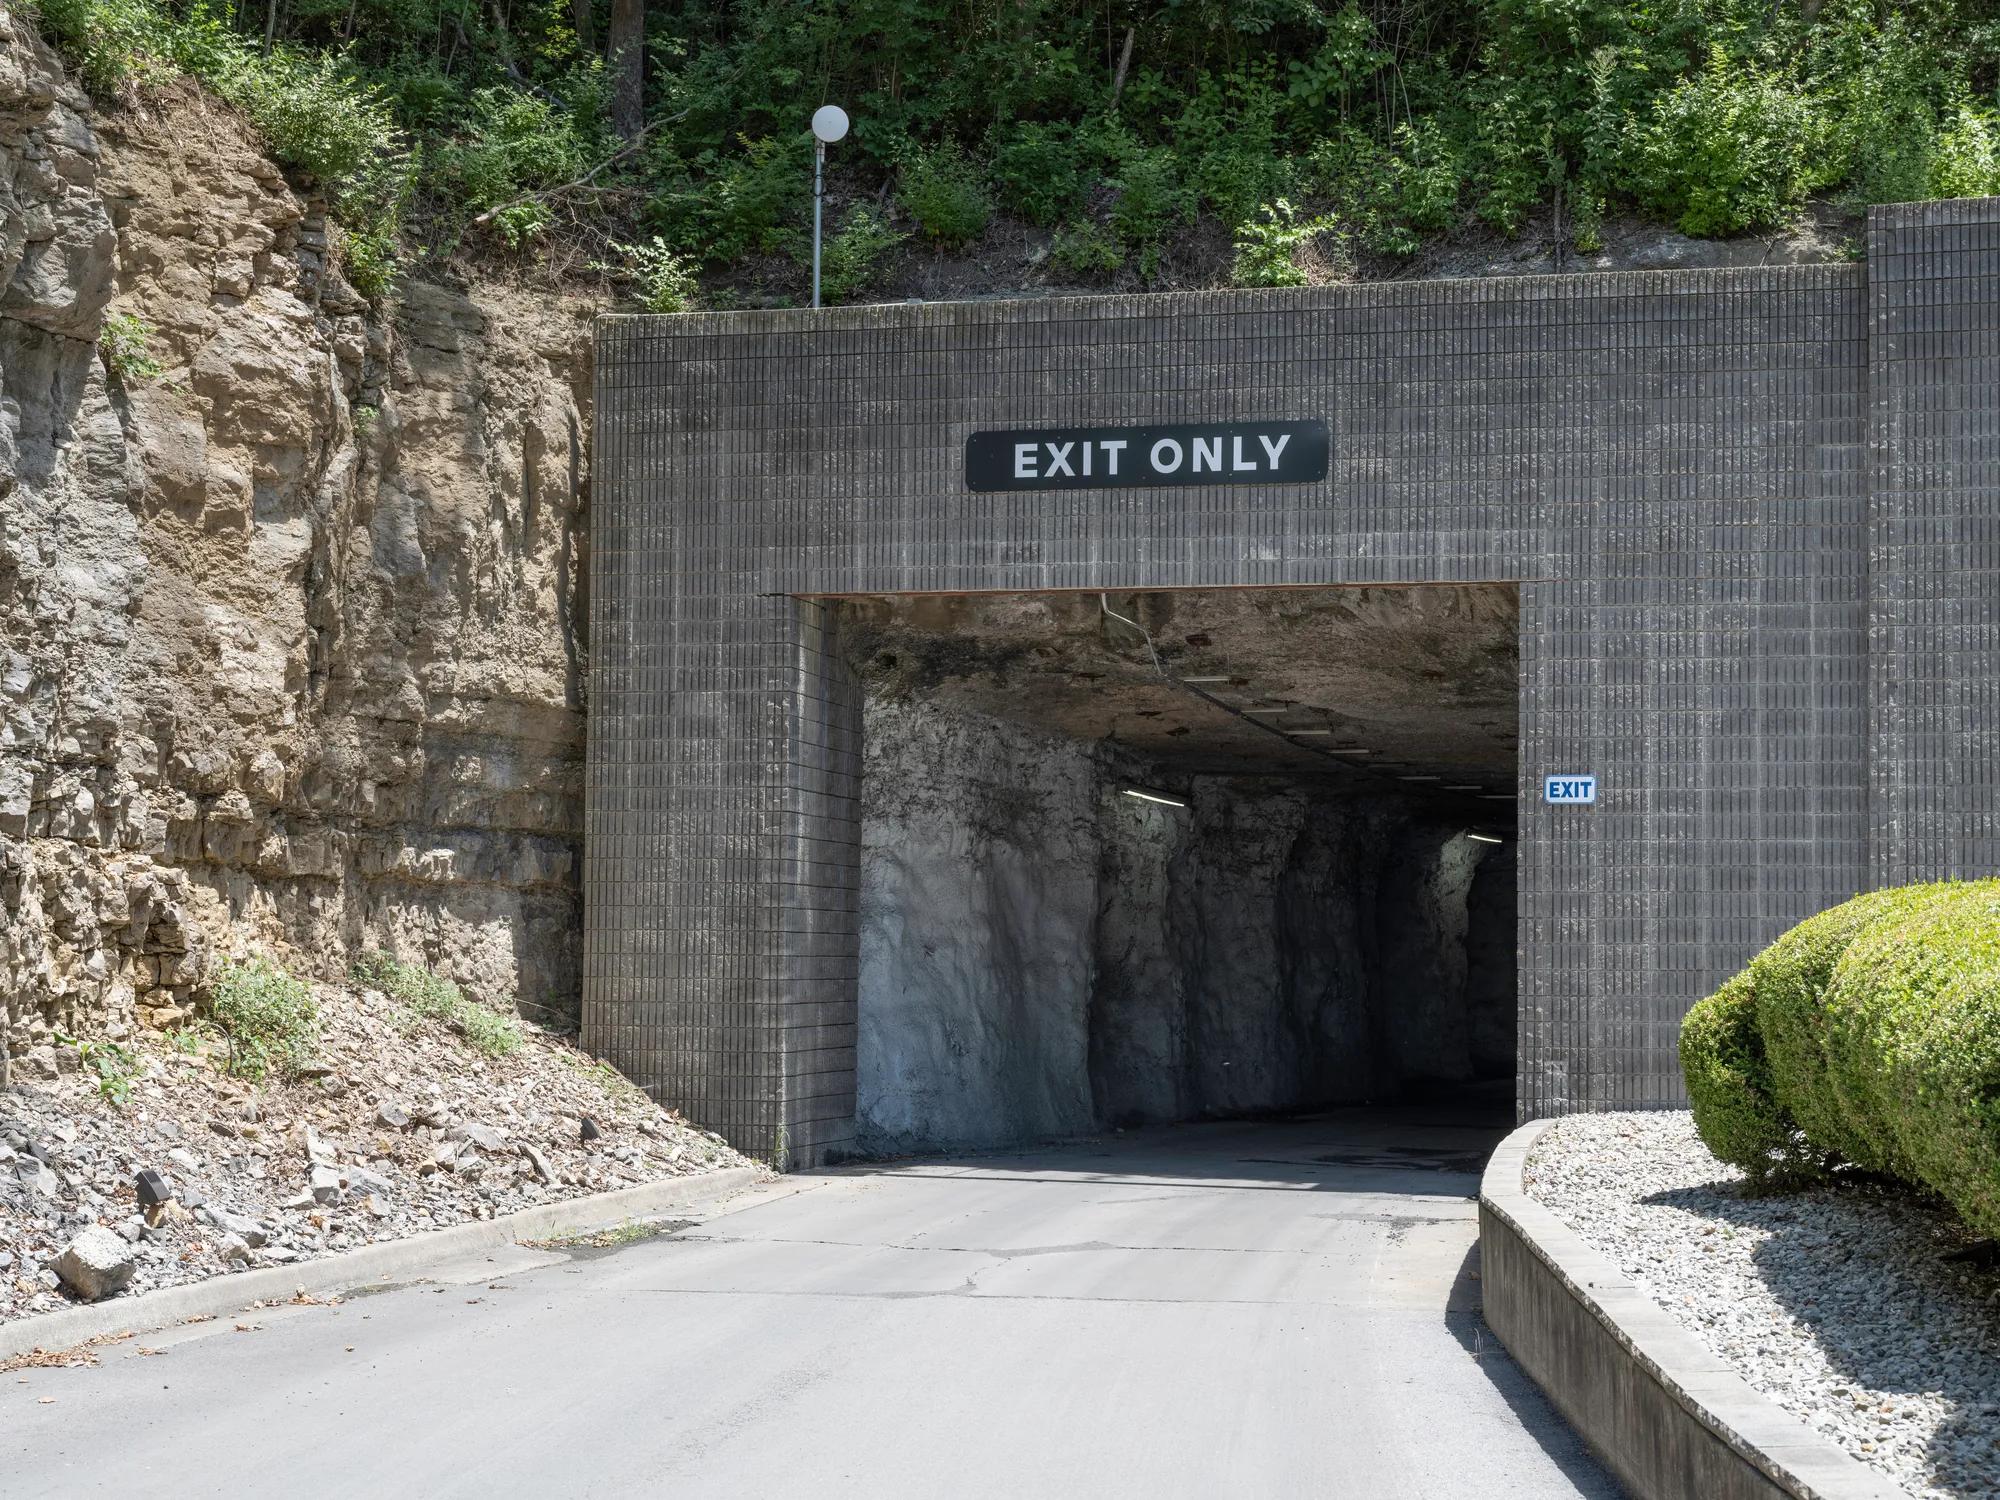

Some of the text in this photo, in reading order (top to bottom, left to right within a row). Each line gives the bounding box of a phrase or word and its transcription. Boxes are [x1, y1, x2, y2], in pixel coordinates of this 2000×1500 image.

[1014, 434, 1291, 478] EXIT ONLY
[1549, 781, 1592, 798] EXIT
